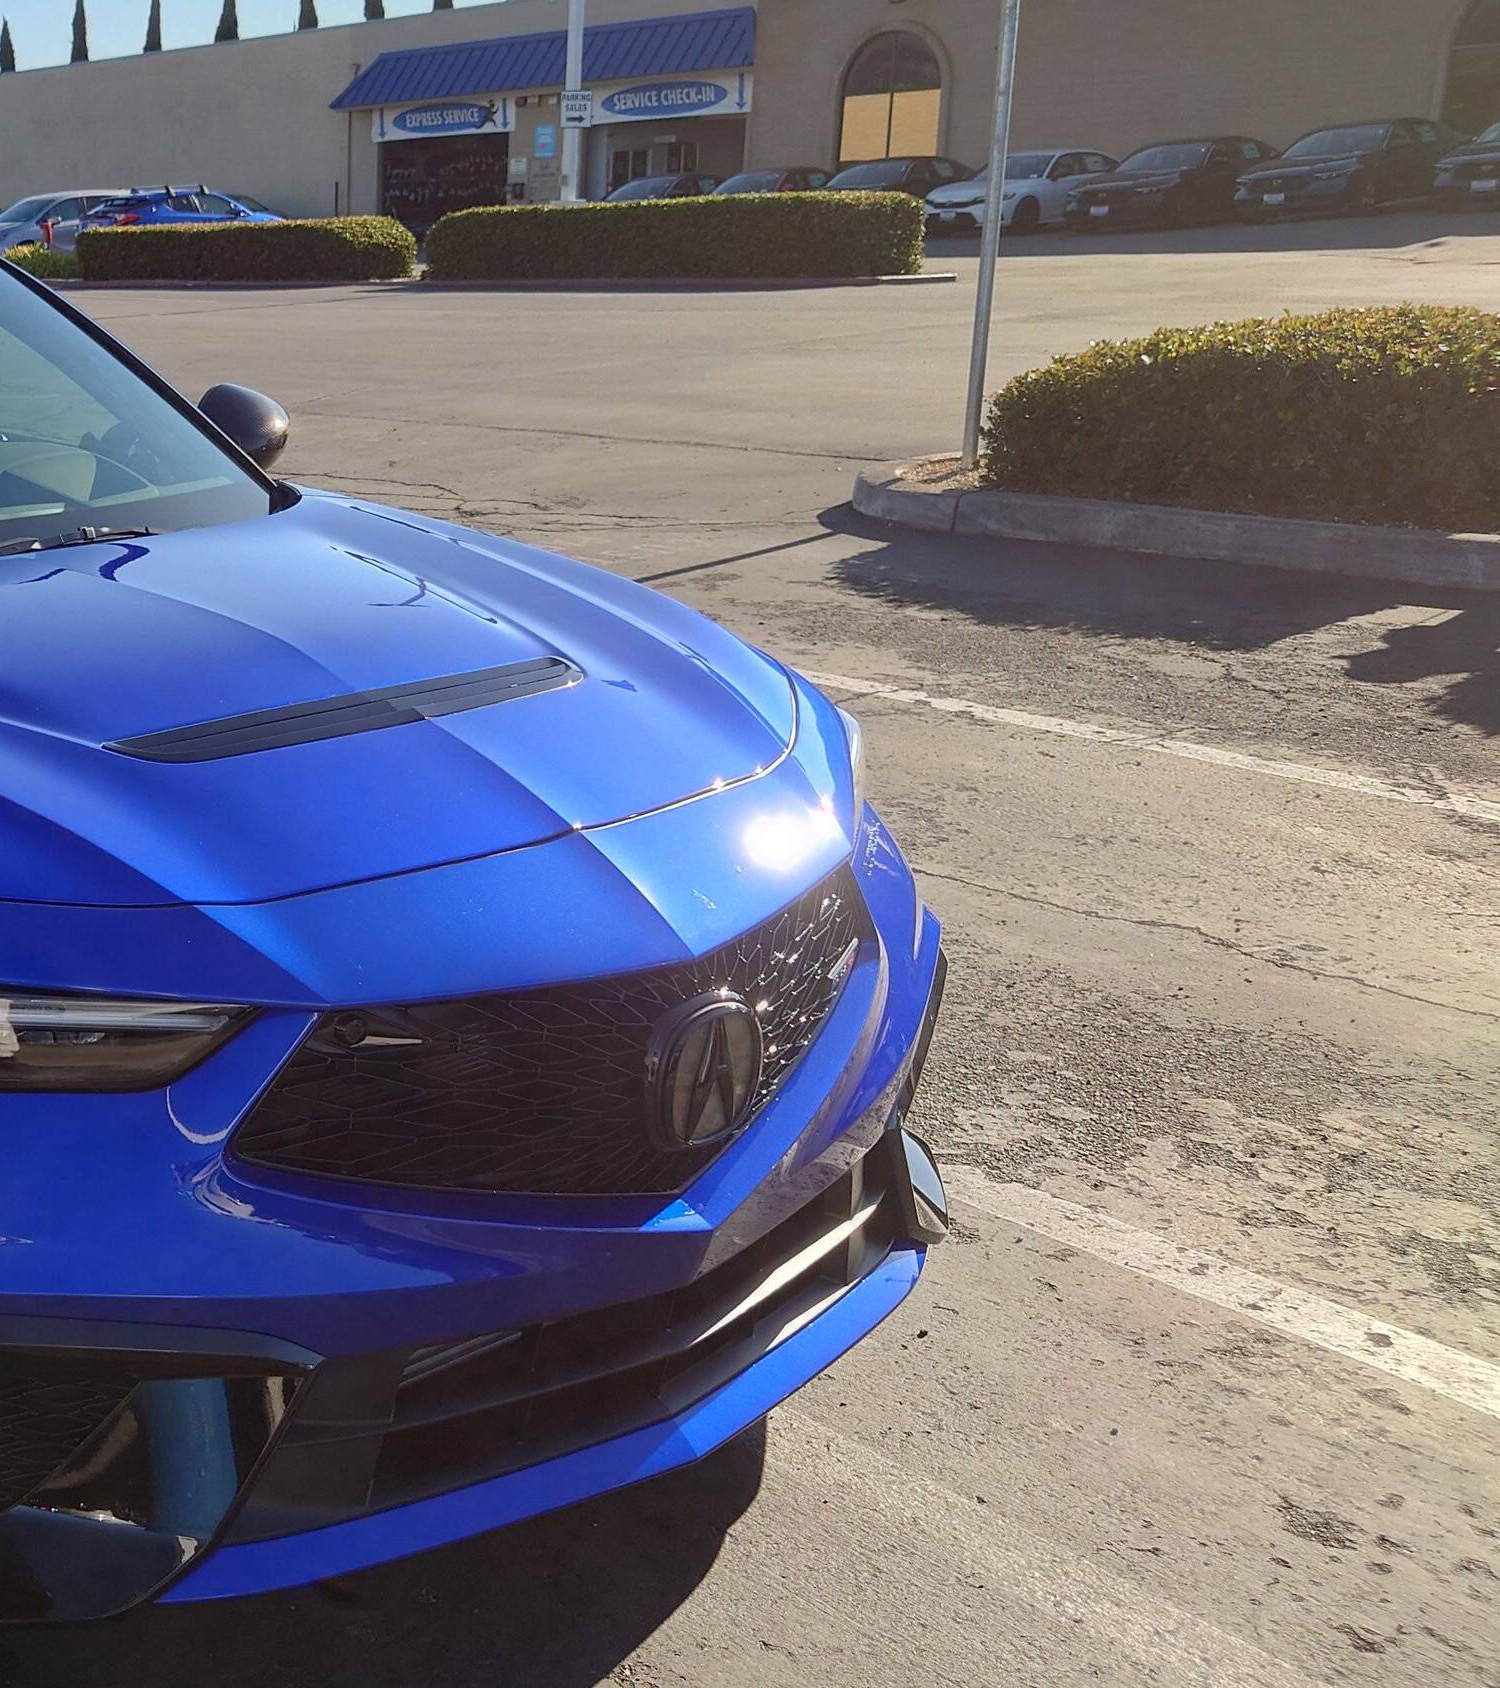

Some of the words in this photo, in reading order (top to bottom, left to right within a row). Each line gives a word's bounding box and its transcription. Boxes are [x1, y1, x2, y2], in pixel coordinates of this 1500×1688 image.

[565, 103, 587, 112] SALES
[613, 91, 658, 110] SERVICE
[660, 85, 715, 106] CHECK-IN
[406, 111, 442, 128] EXPRESS
[443, 108, 479, 124] SERVICE
